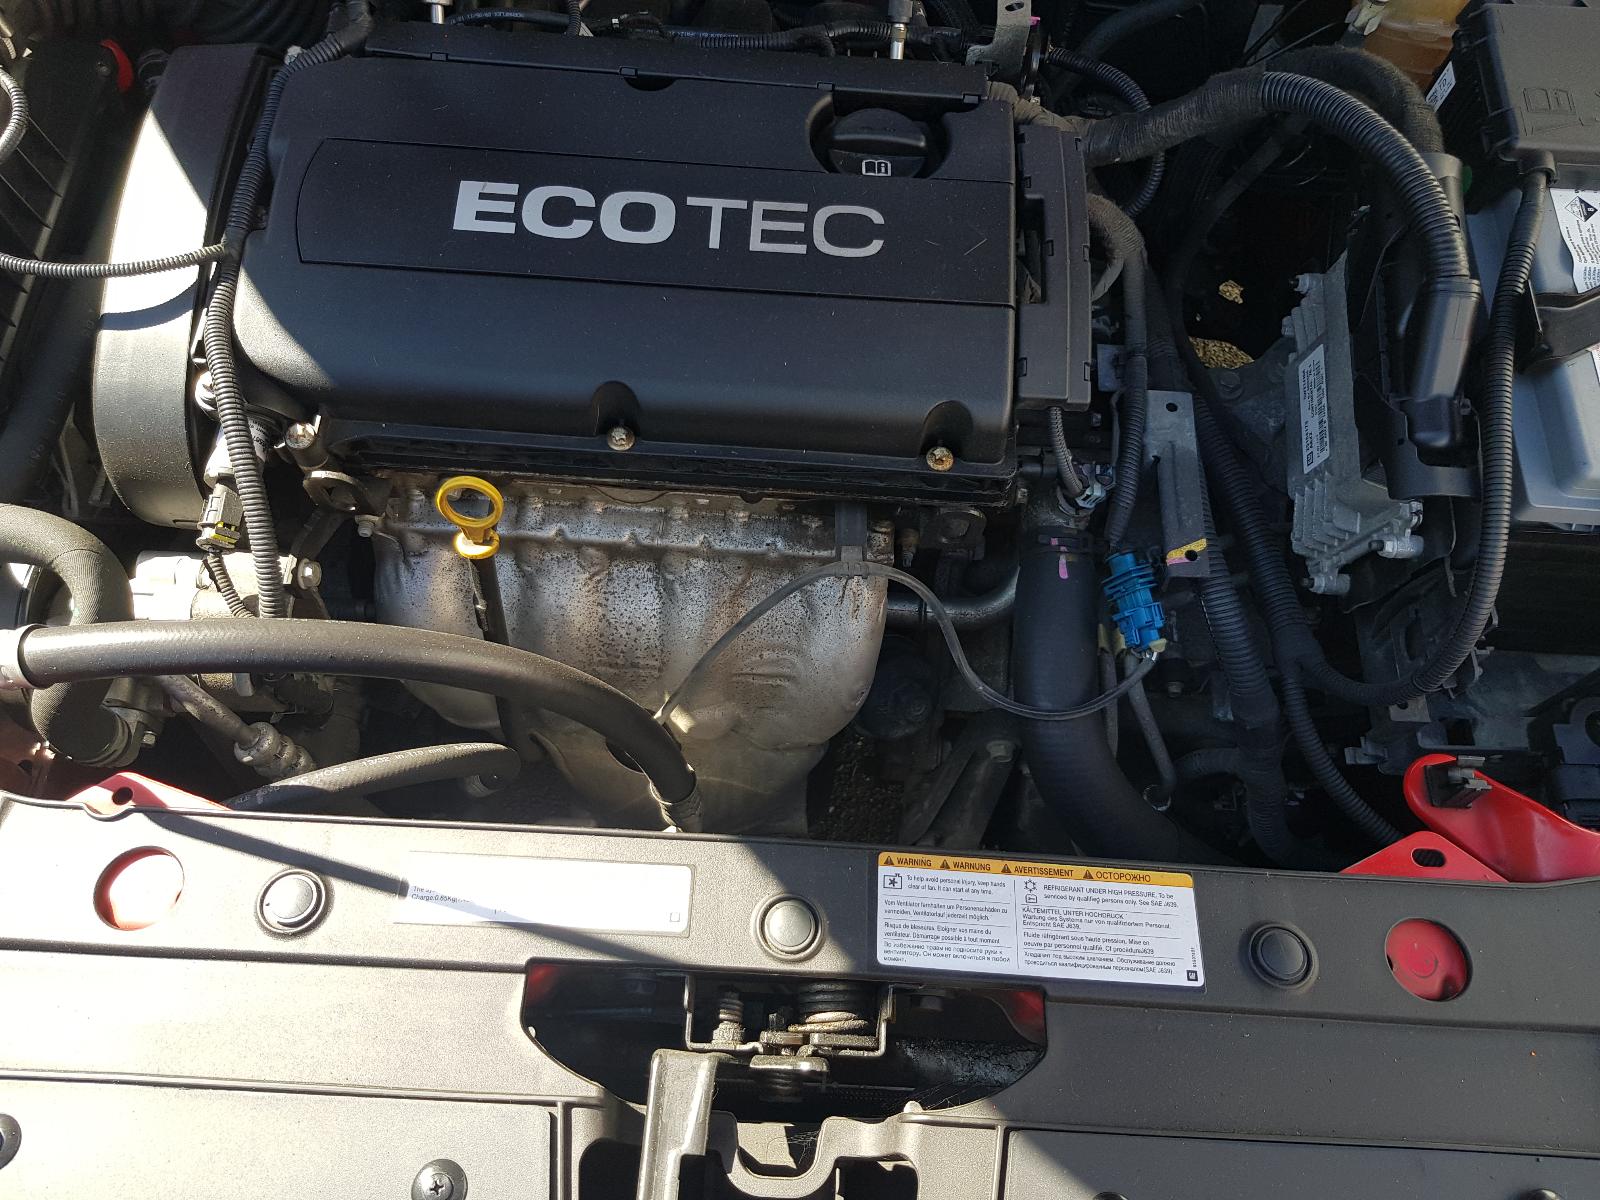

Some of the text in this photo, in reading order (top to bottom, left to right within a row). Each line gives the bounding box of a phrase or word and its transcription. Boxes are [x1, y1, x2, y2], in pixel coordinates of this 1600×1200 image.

[453, 180, 886, 258] ECOTEC
[315, 765, 350, 779] HOSE
[362, 756, 390, 767] 13/32
[897, 857, 932, 867] WARNING
[953, 862, 991, 871] WARNUNG
[1014, 866, 1074, 877] AVERTISSEMENT
[914, 875, 924, 883] help
[1096, 872, 1151, 882] ОСТОРОЖНО
[1044, 885, 1084, 893] REFRIGERANT
[1086, 887, 1107, 895] UNDER
